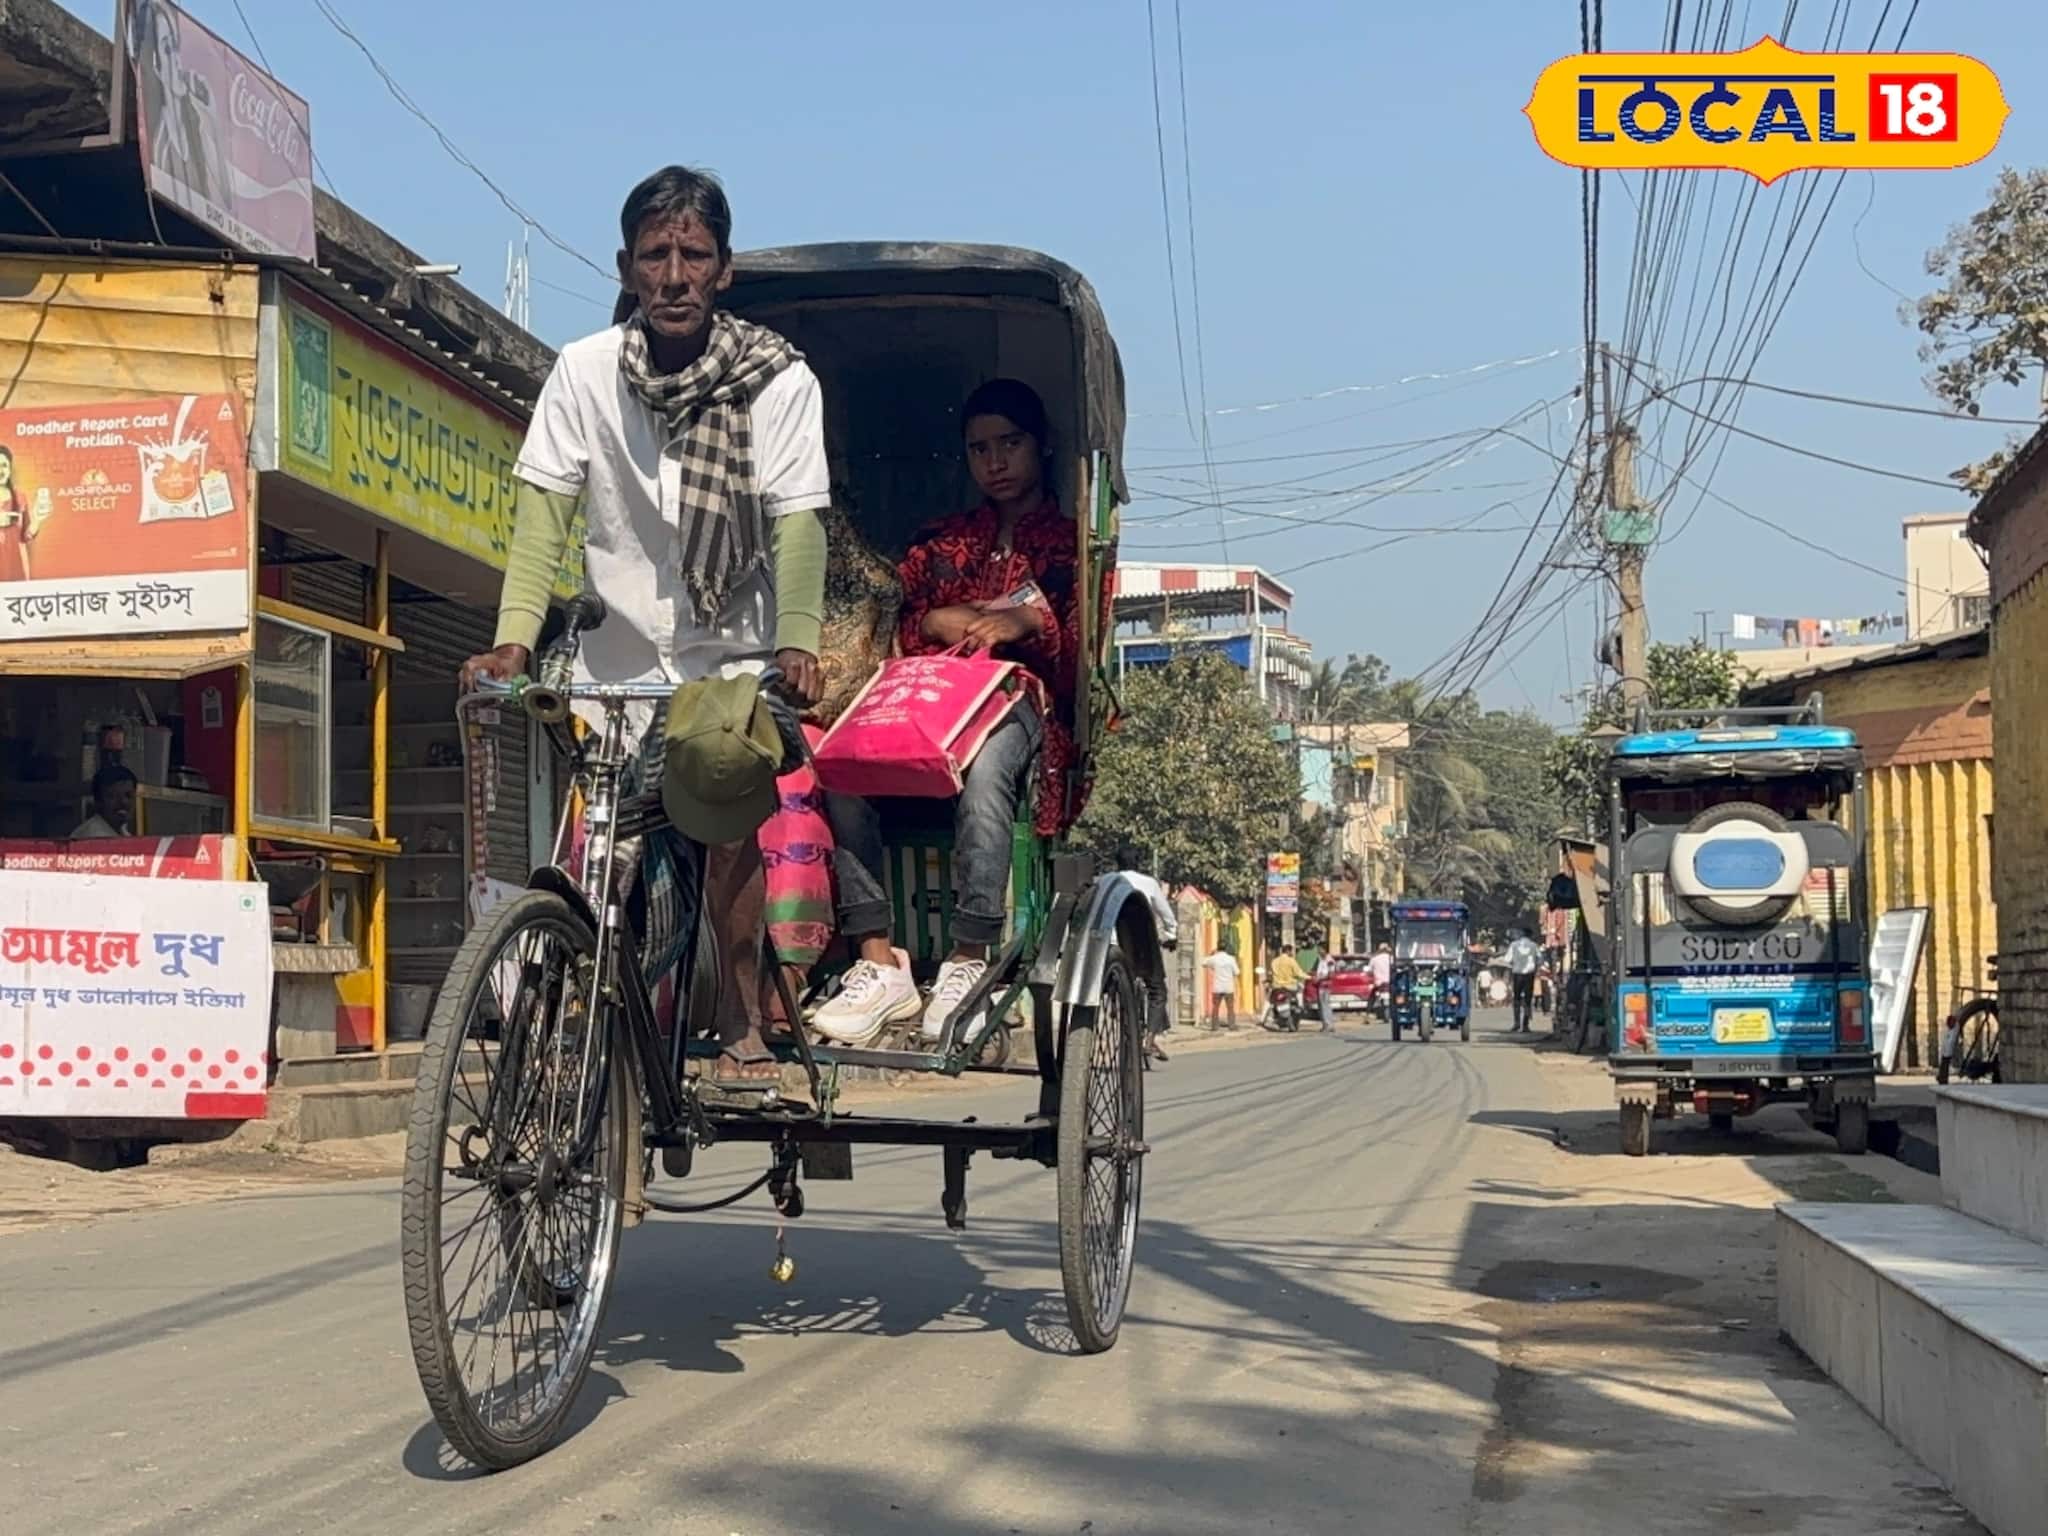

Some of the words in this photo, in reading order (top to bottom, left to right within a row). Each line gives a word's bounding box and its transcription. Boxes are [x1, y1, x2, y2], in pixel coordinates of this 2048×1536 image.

[16, 420, 76, 436] Doodher
[80, 416, 129, 433] Report
[133, 413, 169, 429] Card
[66, 434, 124, 448] Protidin
[72, 496, 118, 513] SELECT
[5, 589, 111, 626] বুড়োরাজ
[117, 580, 195, 620] সুইটস্
[4, 853, 52, 869] oodher
[152, 933, 225, 978] দুধ
[43, 987, 71, 1009] দুধ
